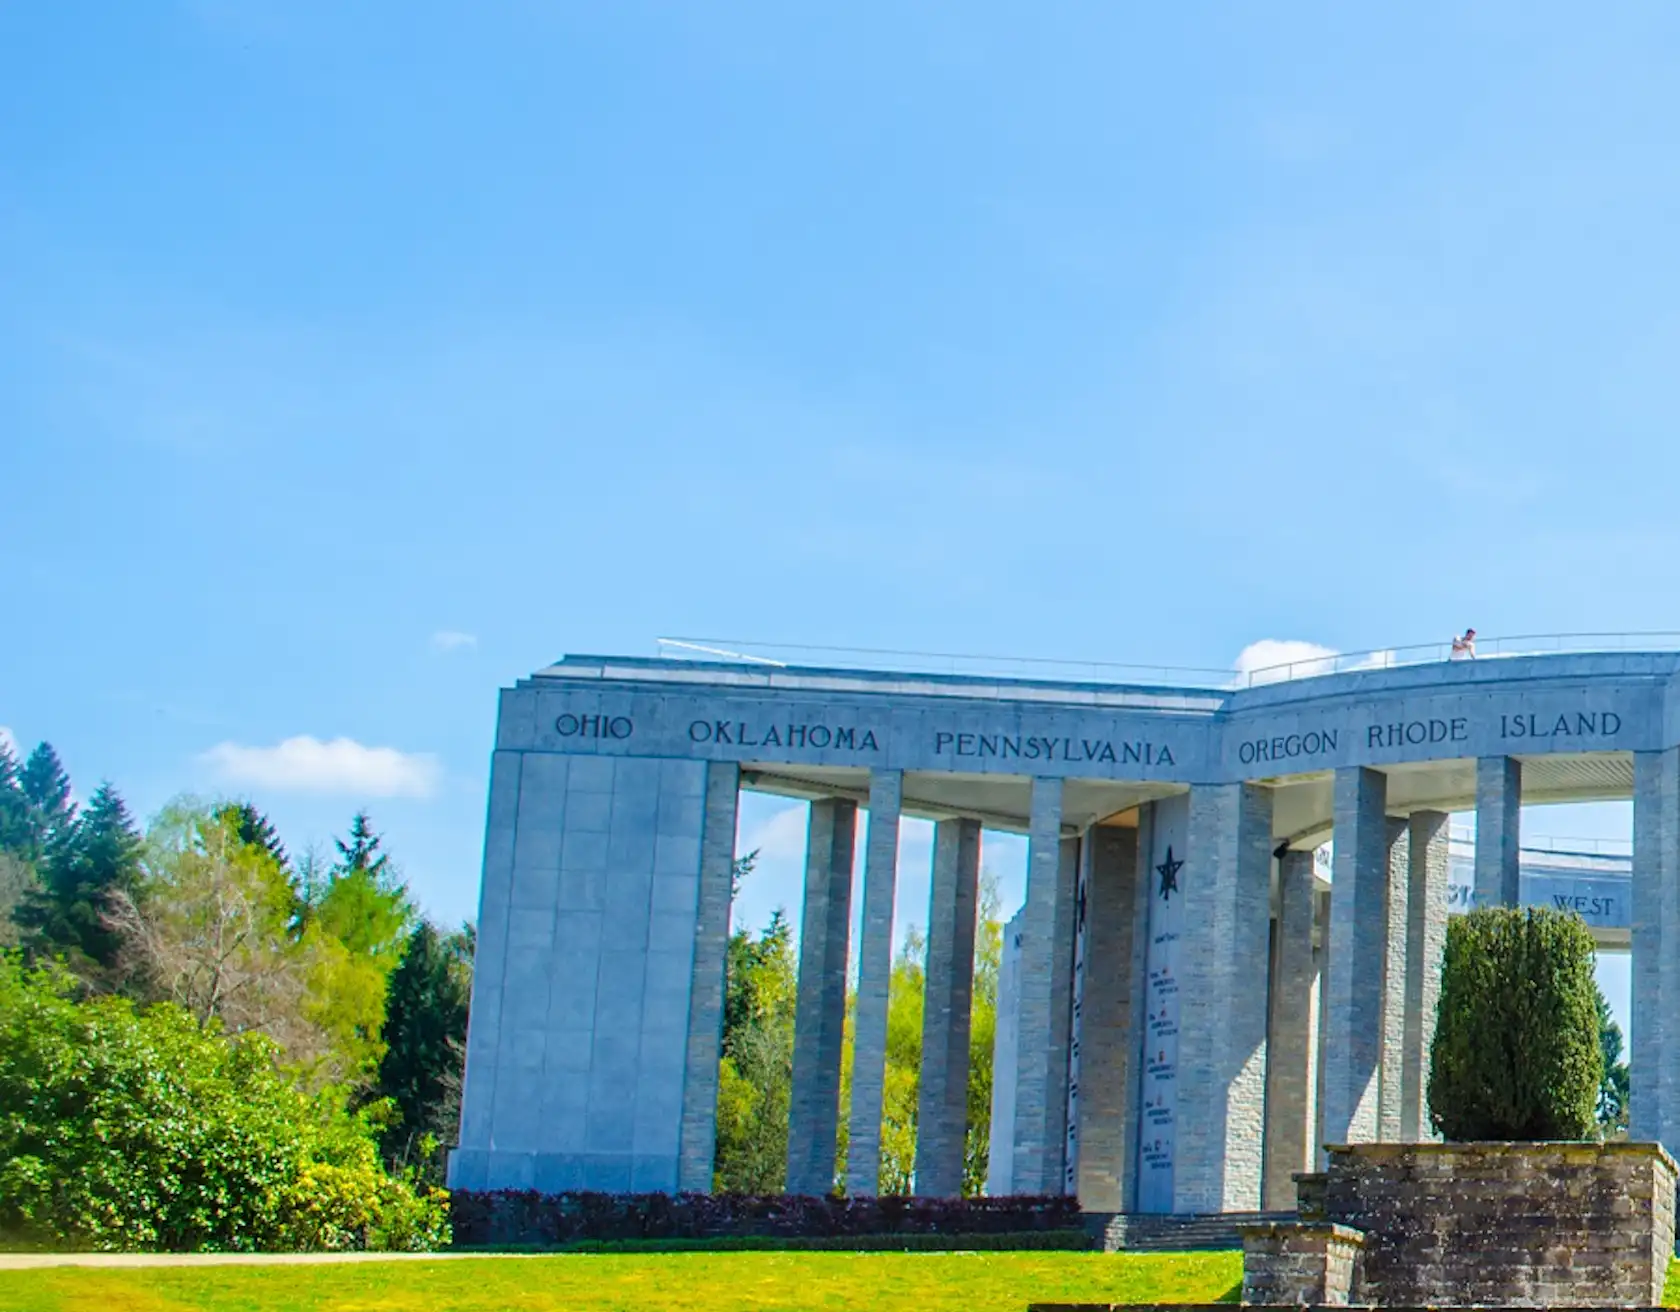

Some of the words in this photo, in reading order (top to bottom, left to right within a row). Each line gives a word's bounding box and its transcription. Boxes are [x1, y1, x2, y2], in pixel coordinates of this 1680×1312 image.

[556, 713, 633, 739] OHIO
[689, 720, 879, 751] OKLAHOMA
[935, 732, 1176, 766] PENNSYLVANIA
[1239, 729, 1338, 765] OREGON
[1368, 718, 1469, 749] RHODE
[1501, 712, 1622, 739] ISLAND
[1552, 894, 1615, 916] WEST
